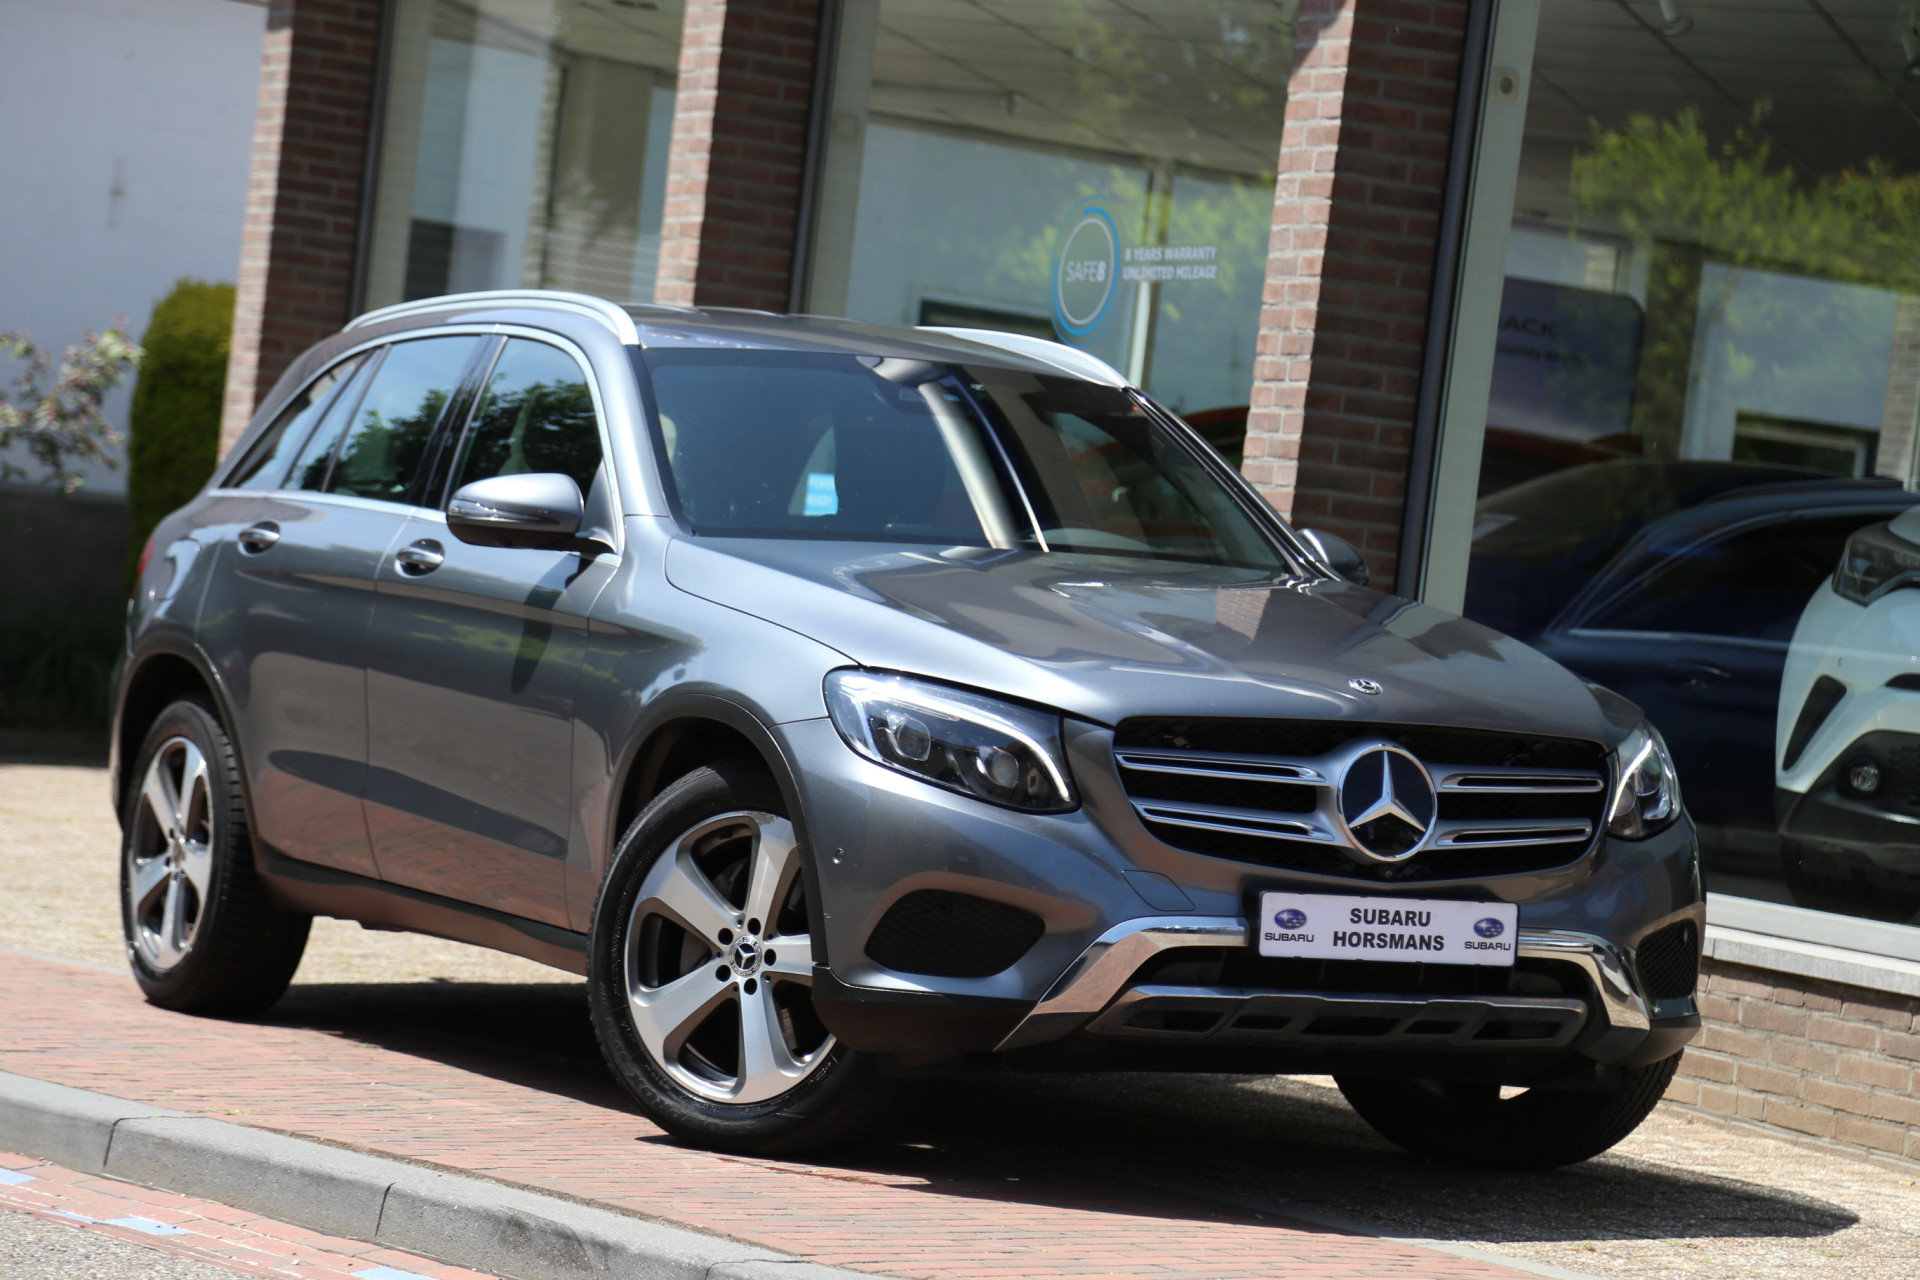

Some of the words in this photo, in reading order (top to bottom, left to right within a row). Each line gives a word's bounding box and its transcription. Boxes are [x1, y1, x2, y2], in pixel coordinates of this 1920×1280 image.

[1134, 247, 1163, 261] YEARS
[1164, 246, 1218, 261] WARRANTY
[1066, 260, 1106, 282] SAFE8
[1123, 265, 1174, 281] UNLIMITED
[1175, 265, 1218, 280] MILEAGE
[1349, 907, 1431, 927] SUBARU
[1264, 932, 1315, 943] SUBARU
[1332, 931, 1445, 951] HORSMANS
[1464, 941, 1512, 951] SUBARU
